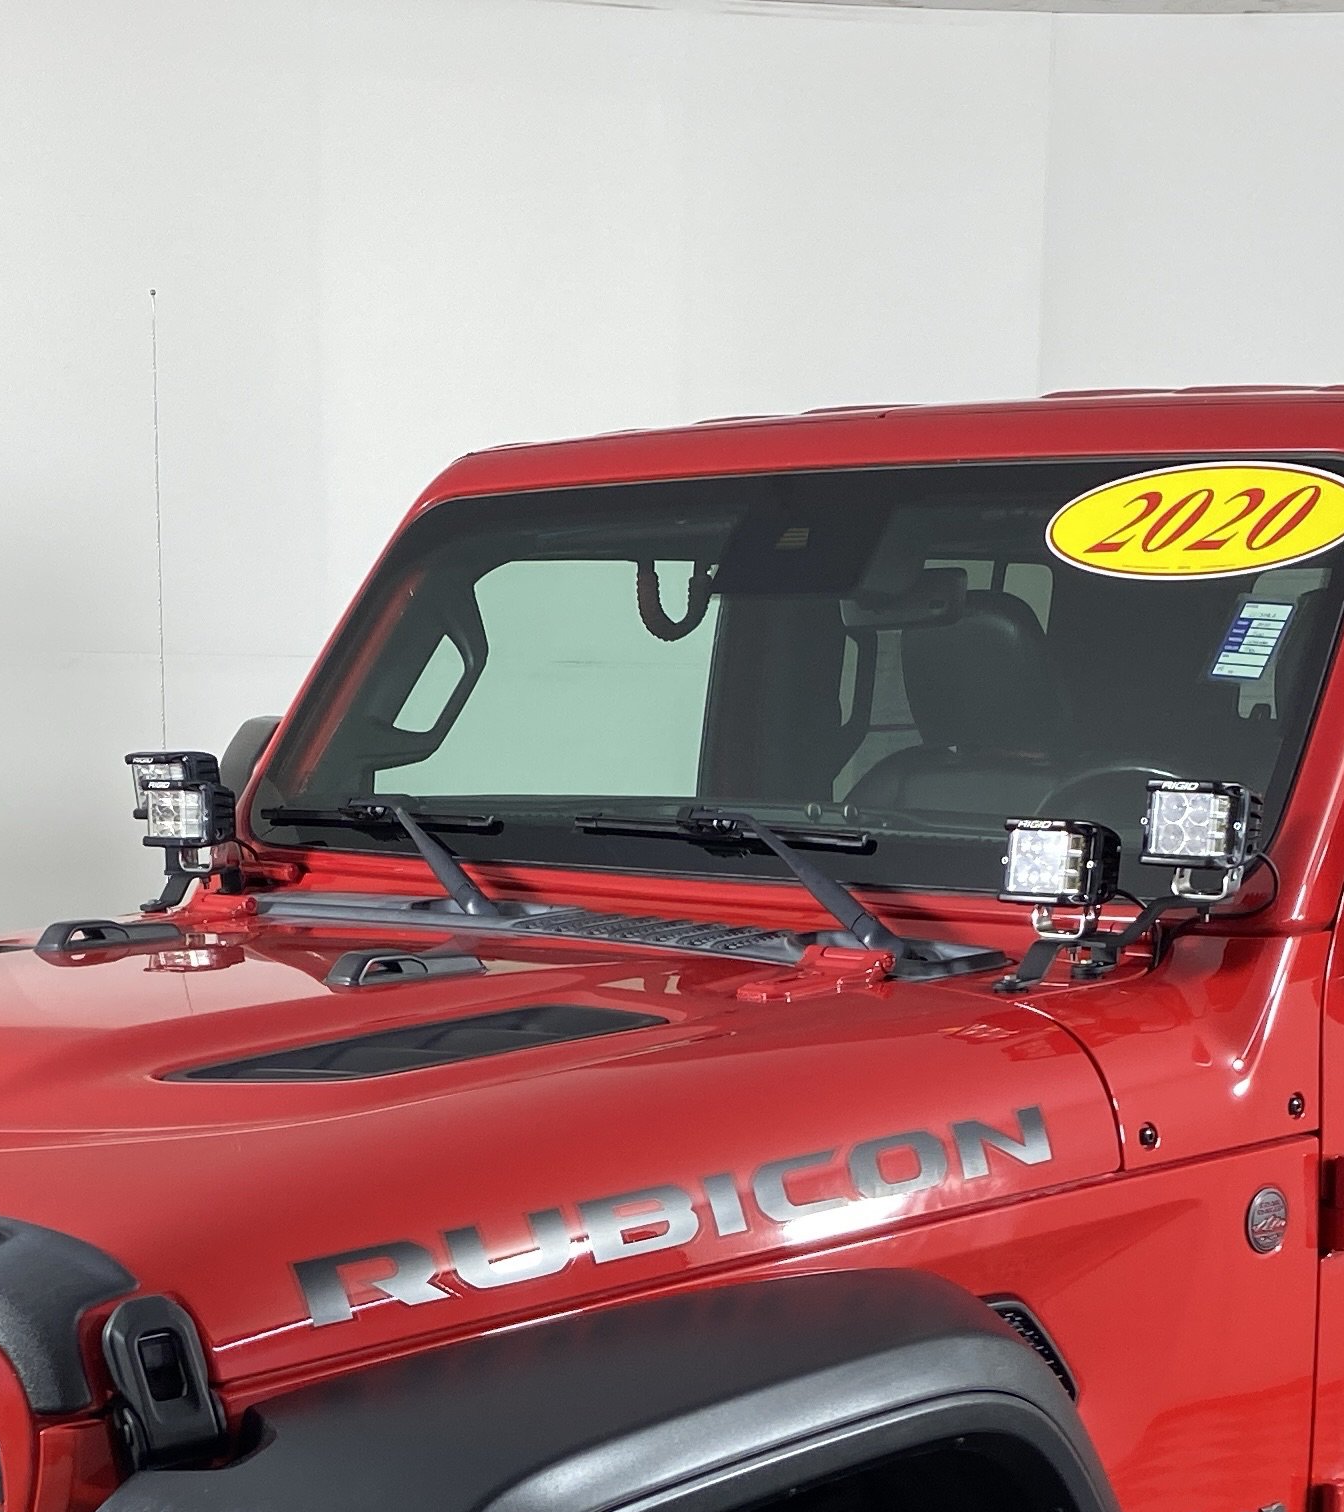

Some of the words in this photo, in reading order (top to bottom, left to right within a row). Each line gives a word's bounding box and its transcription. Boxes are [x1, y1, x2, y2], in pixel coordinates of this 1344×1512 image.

[1082, 485, 1322, 553] 2020
[1161, 780, 1200, 791] RIGID
[1017, 819, 1053, 830] RIGID
[292, 1105, 1054, 1327] RUBICON
